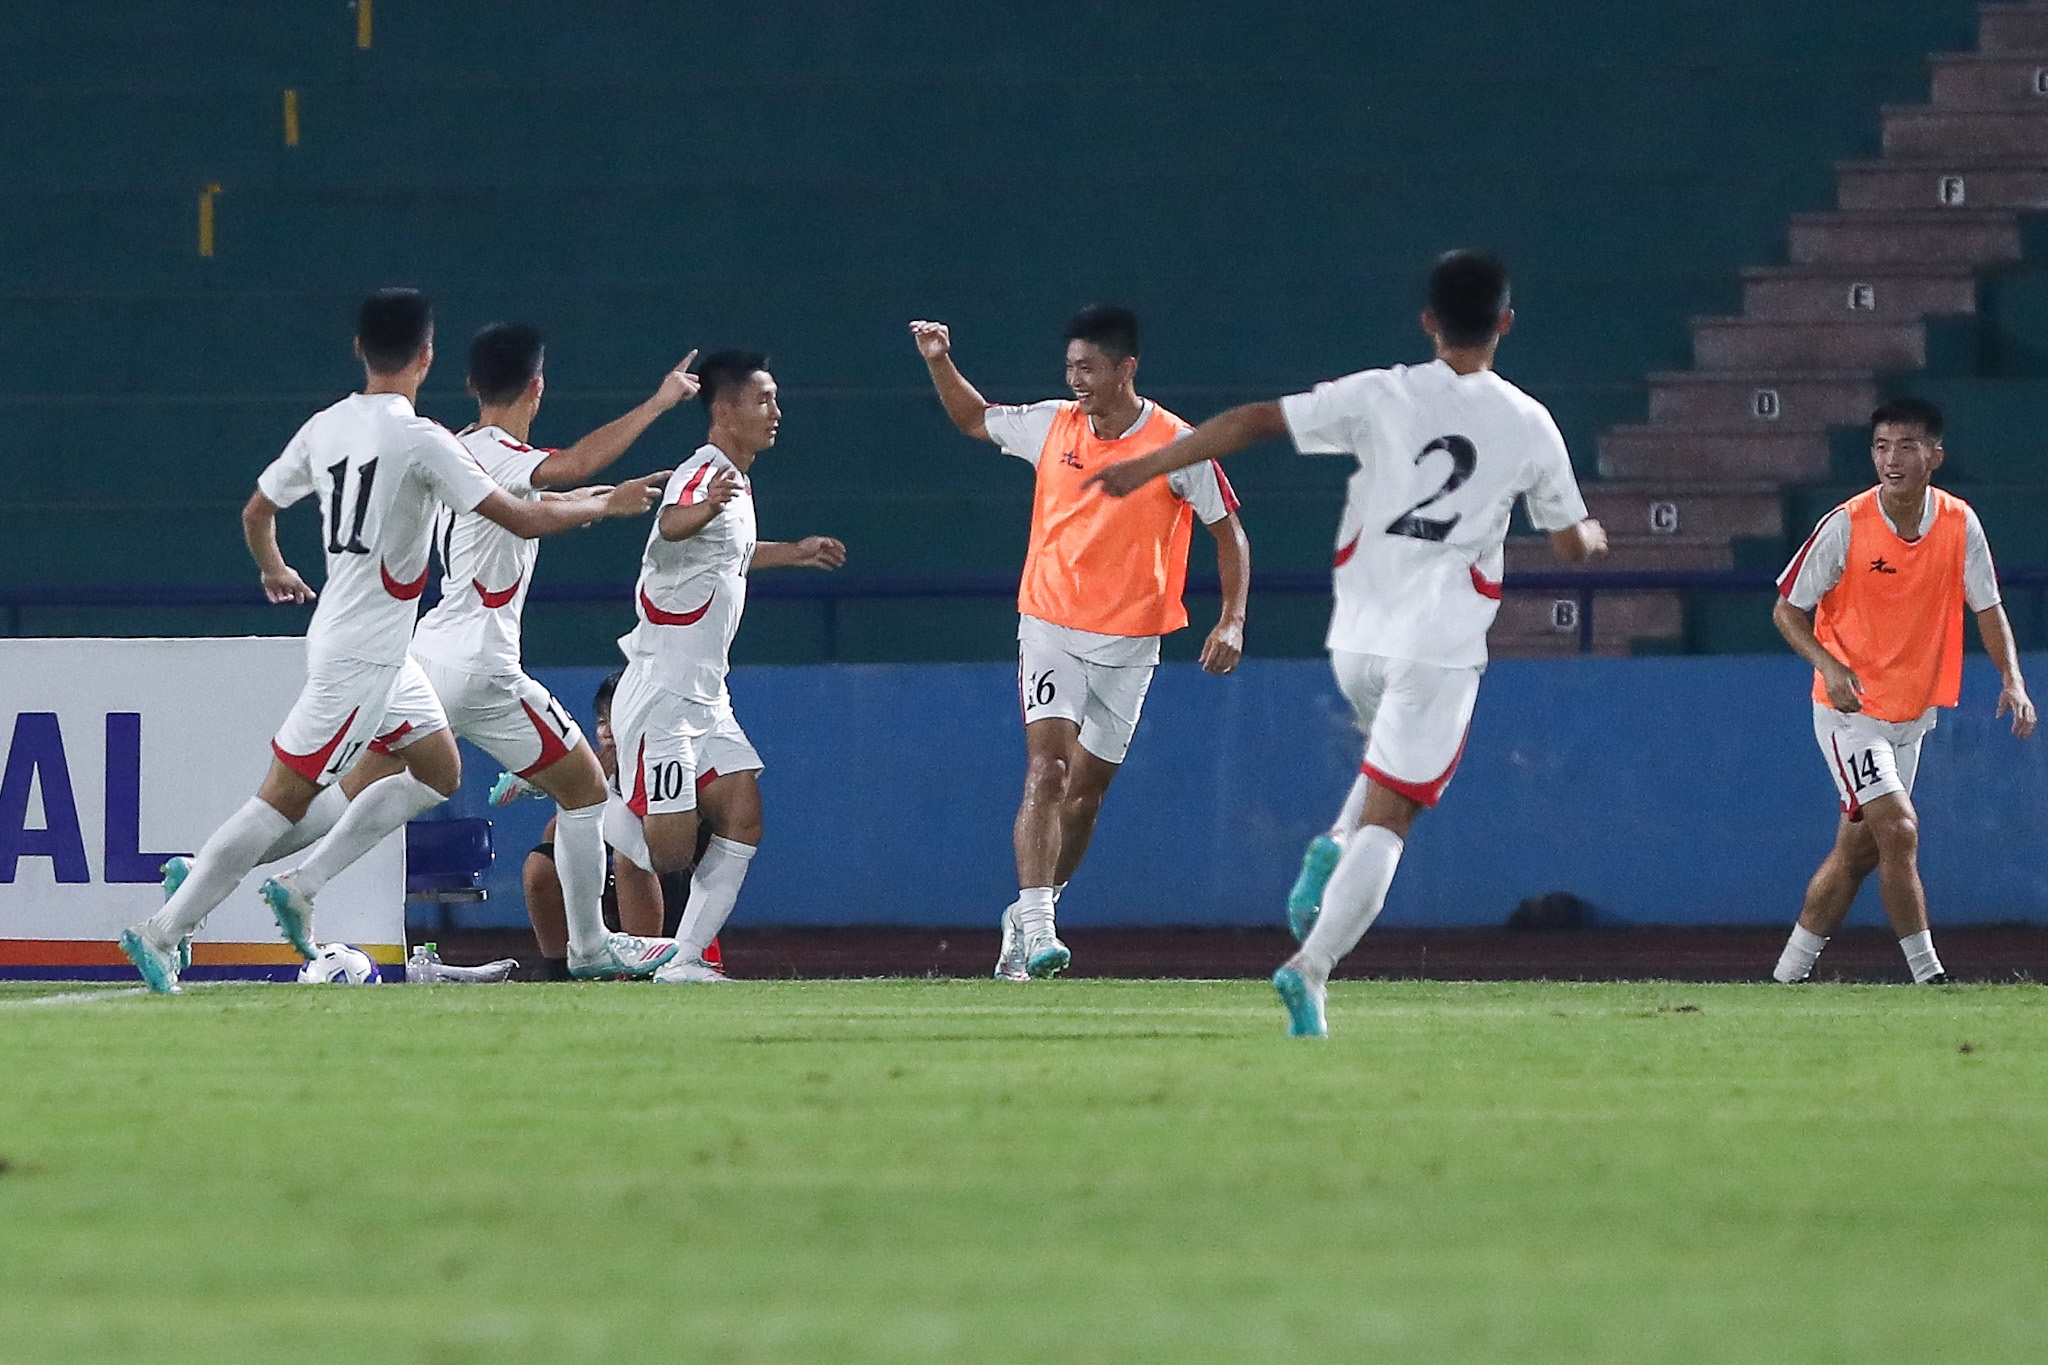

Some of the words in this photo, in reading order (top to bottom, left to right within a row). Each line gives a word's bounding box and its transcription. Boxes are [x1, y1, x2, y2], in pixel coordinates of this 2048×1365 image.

[1944, 178, 1960, 203] F
[1757, 392, 1776, 415] D
[327, 455, 379, 554] 11
[1385, 435, 1477, 542] 2
[1654, 505, 1672, 528] C
[1556, 602, 1574, 626] B
[650, 760, 683, 802] 10
[1847, 748, 1882, 793] 14
